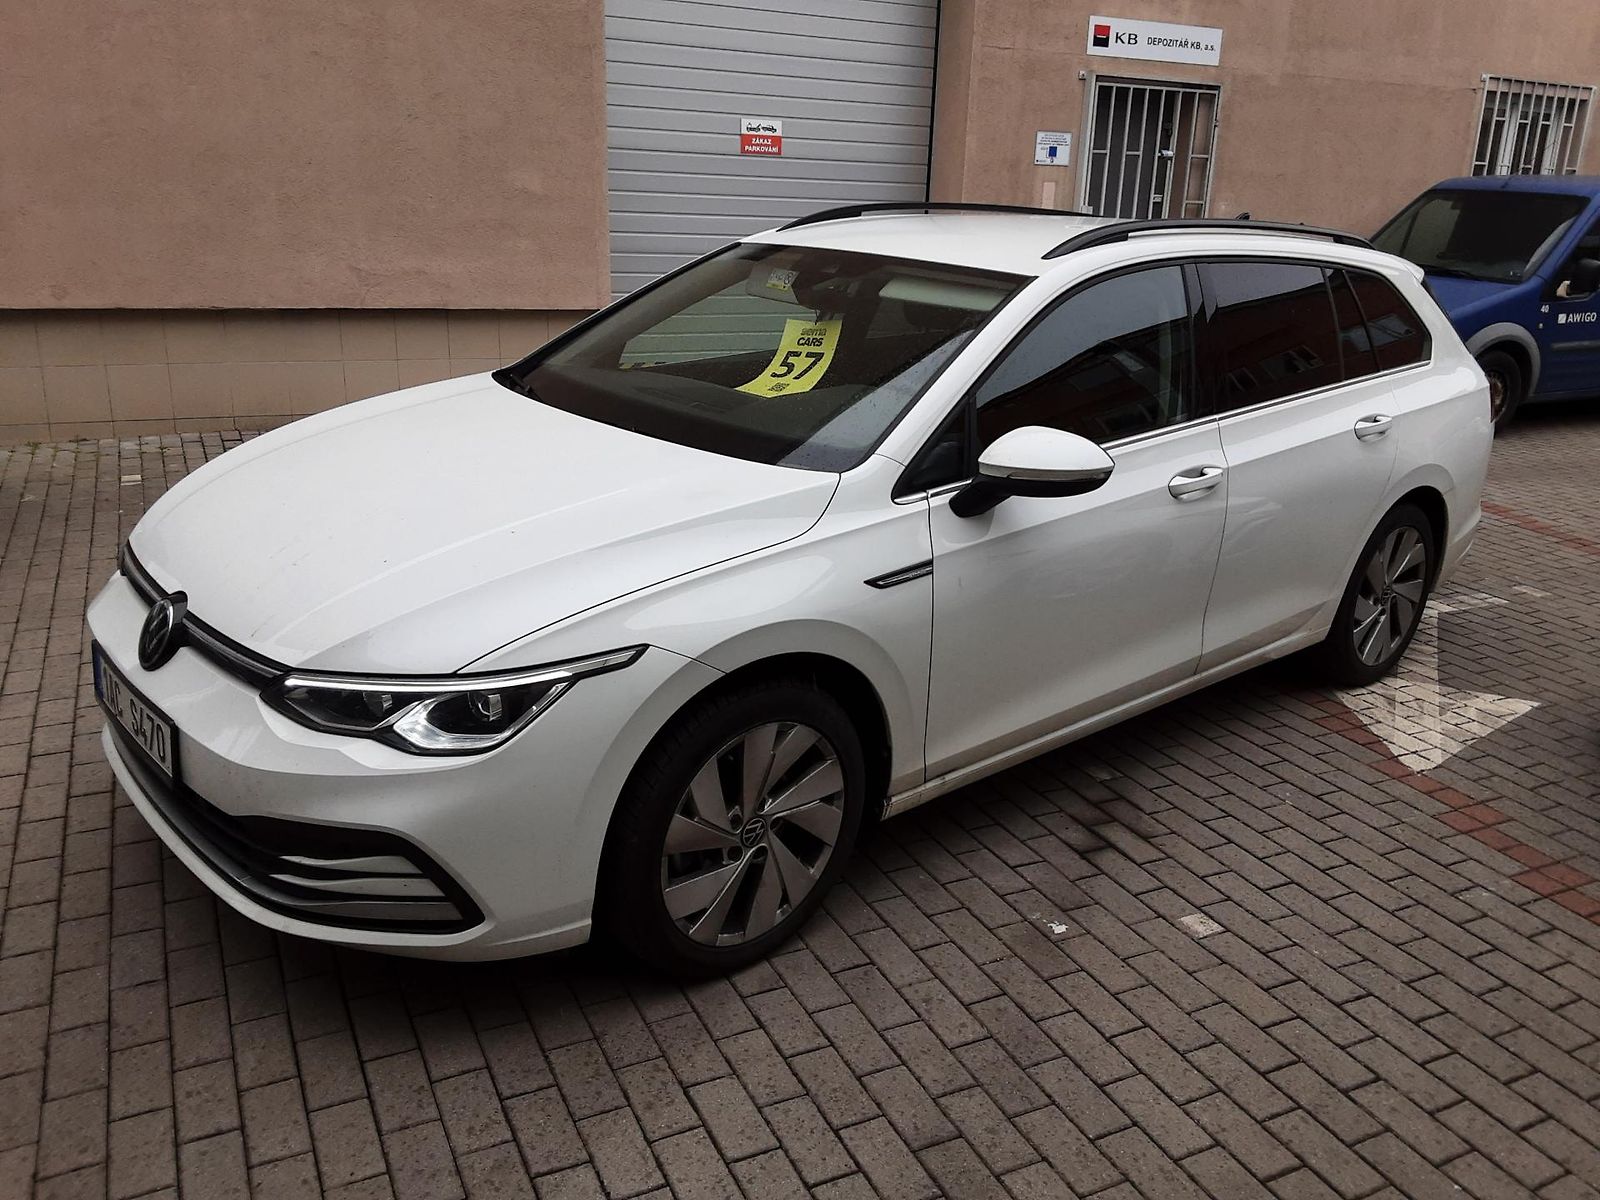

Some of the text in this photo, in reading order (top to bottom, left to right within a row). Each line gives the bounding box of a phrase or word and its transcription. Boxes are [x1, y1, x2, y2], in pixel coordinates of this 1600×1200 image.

[1114, 32, 1138, 45] KB
[1190, 42, 1203, 51] KB,
[1204, 44, 1216, 52] a.s.
[752, 137, 772, 145] ZÁKAZ
[744, 145, 779, 153] PARKOVÁNÍ
[1567, 312, 1597, 323] AWIGO
[796, 337, 824, 347] CARS
[770, 350, 825, 380] 57
